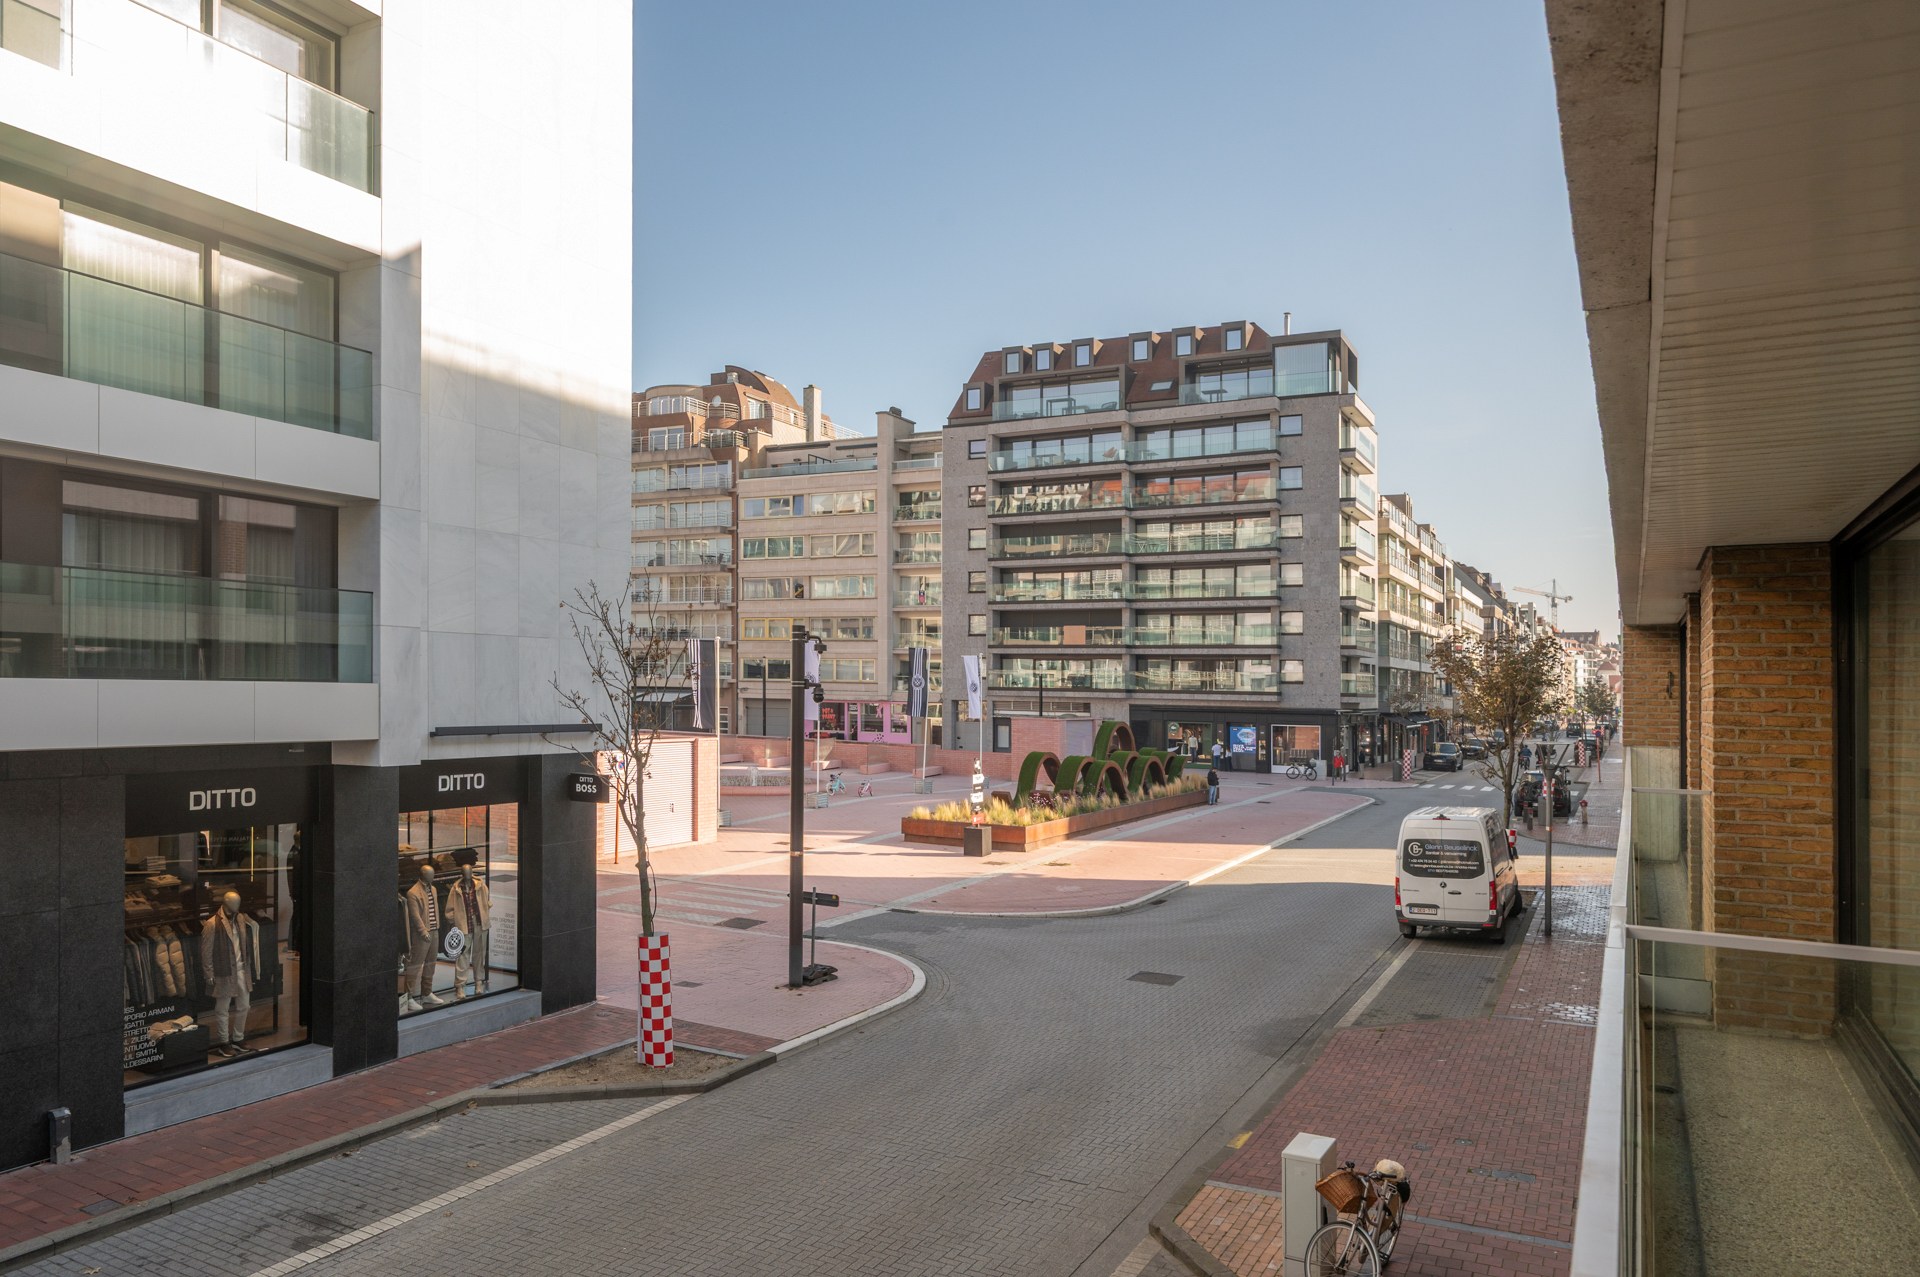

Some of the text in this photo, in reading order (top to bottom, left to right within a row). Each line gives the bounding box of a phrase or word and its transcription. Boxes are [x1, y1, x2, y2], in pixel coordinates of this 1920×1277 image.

[438, 773, 485, 792] DITTO
[575, 784, 597, 793] BOSS
[189, 787, 256, 811] DITTO
[148, 1006, 175, 1016] ARMANI
[136, 1047, 158, 1058] SMITH
